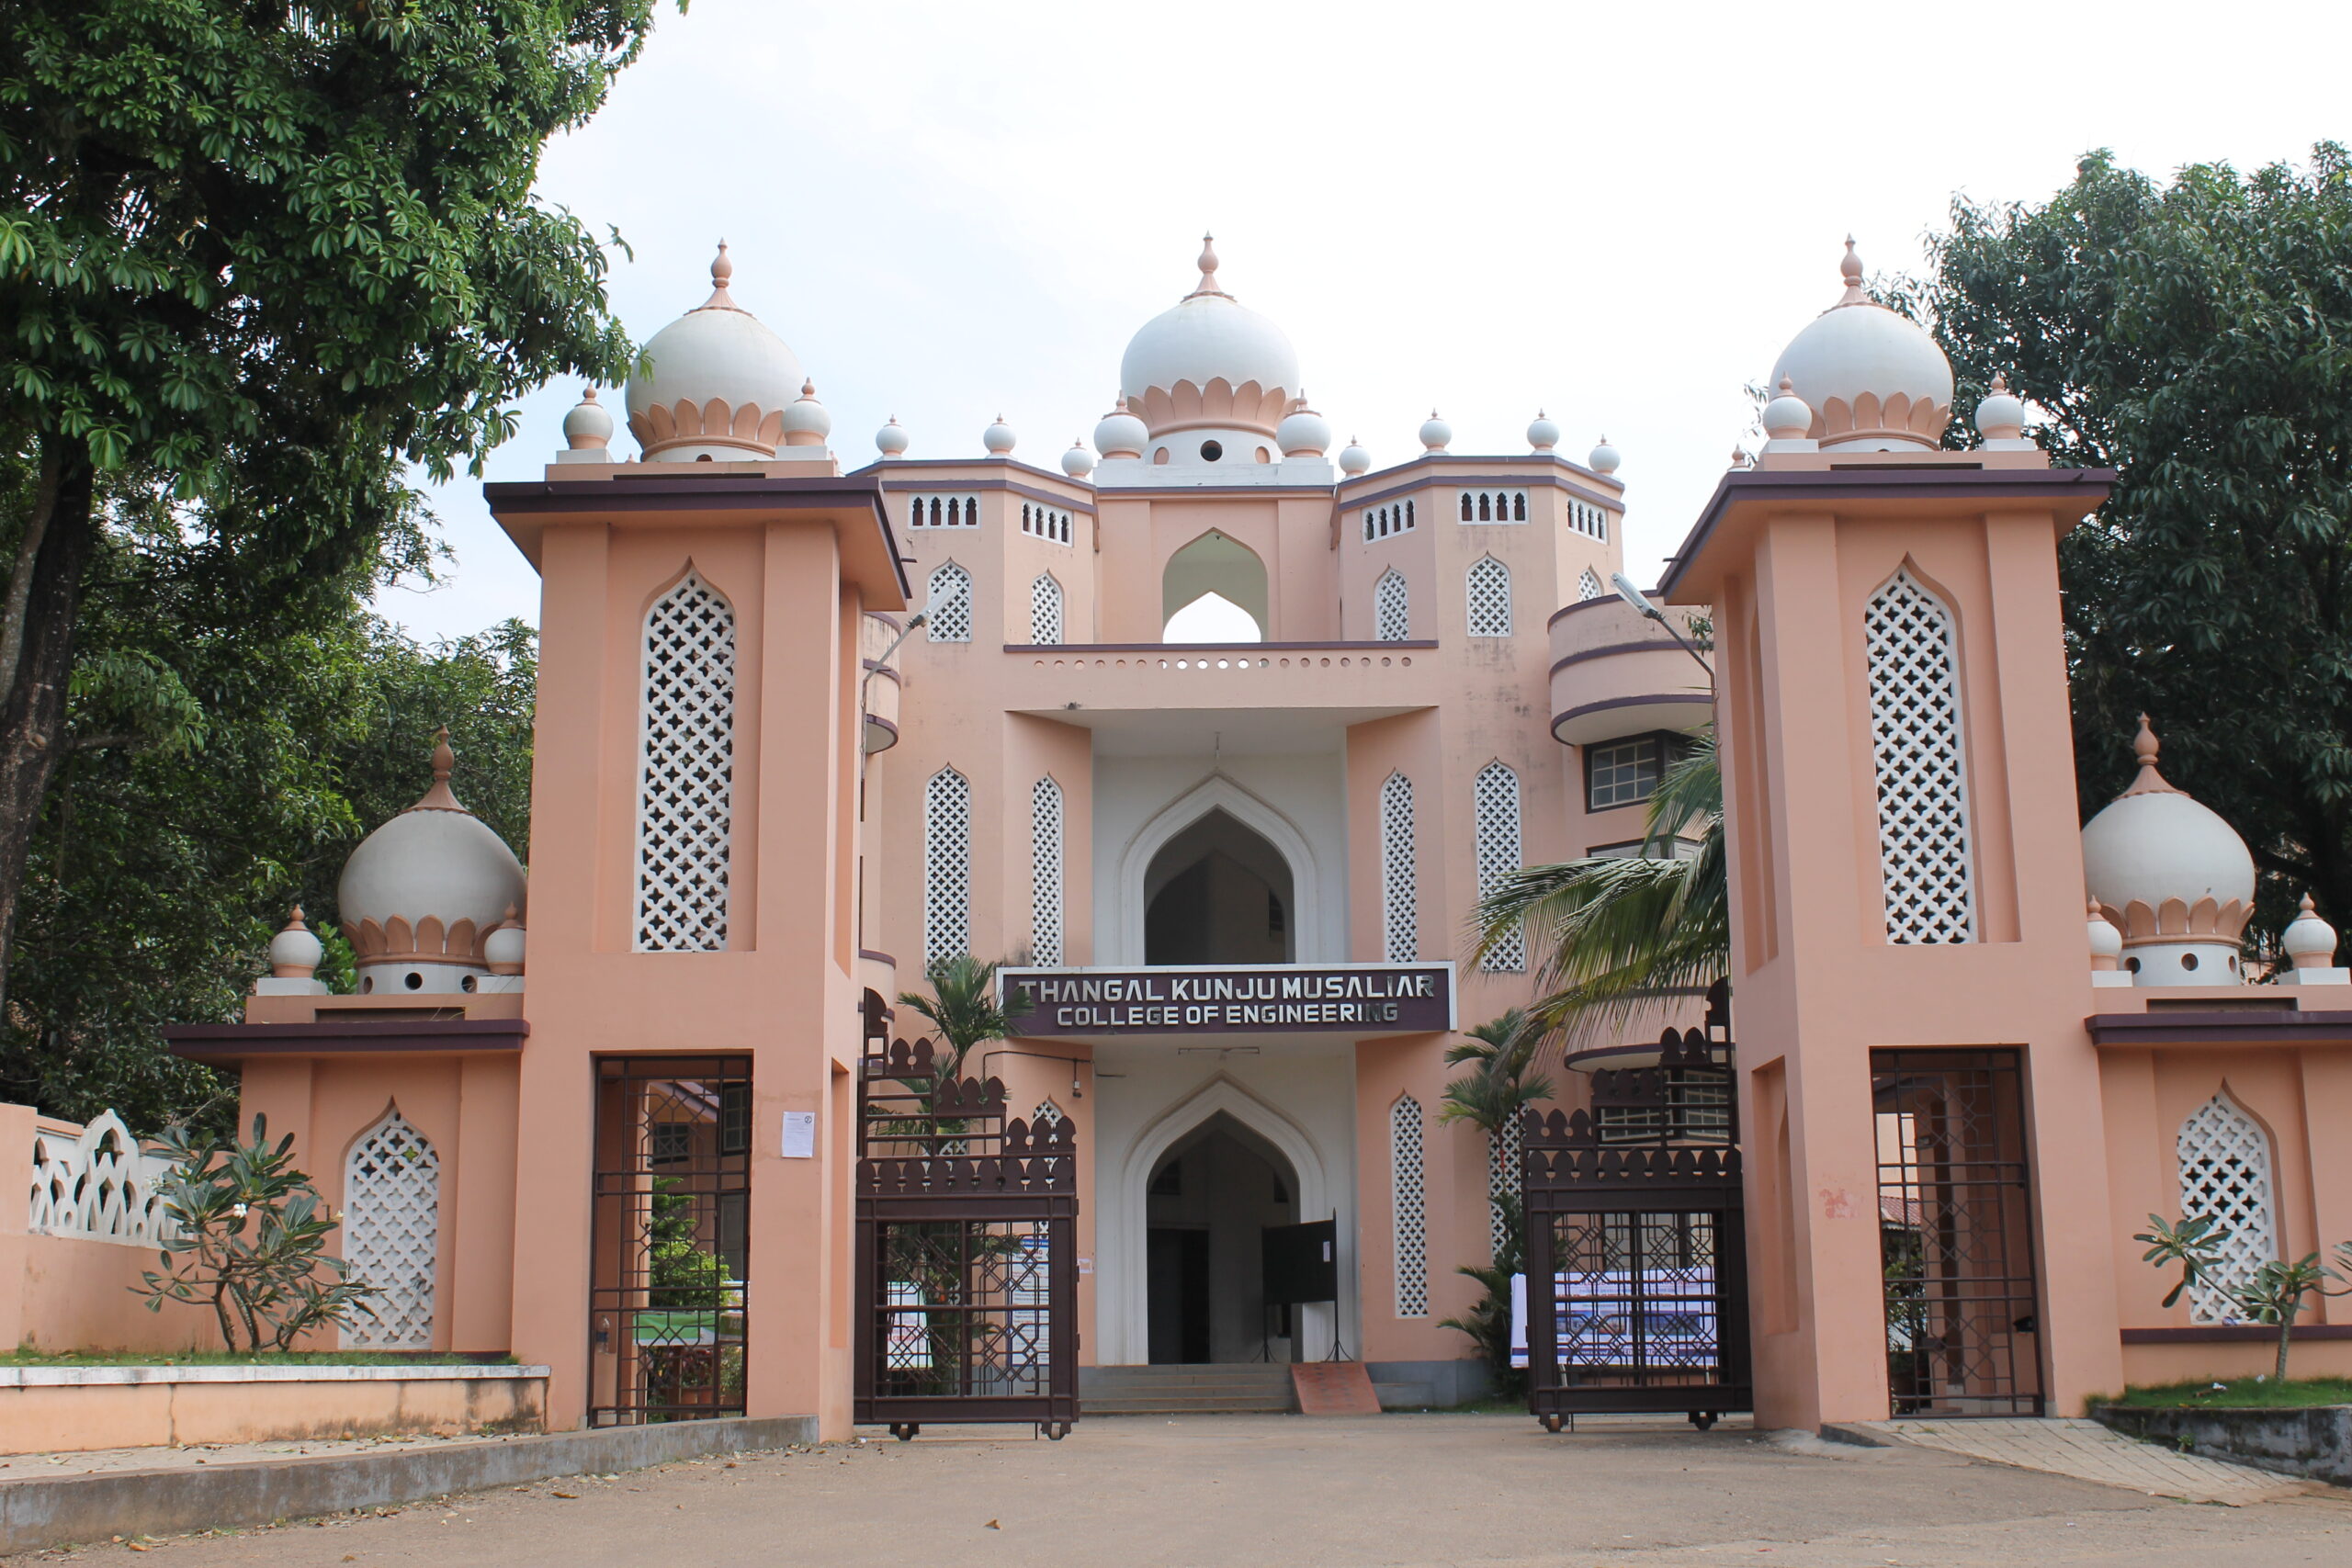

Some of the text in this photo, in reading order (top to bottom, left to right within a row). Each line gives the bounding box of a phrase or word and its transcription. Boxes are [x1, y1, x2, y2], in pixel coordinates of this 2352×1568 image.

[1018, 976, 1435, 1003] THANGAL KUNJU MUSALIAR
[1057, 1003, 1398, 1026] COLLEGE OF ENGINEERING
